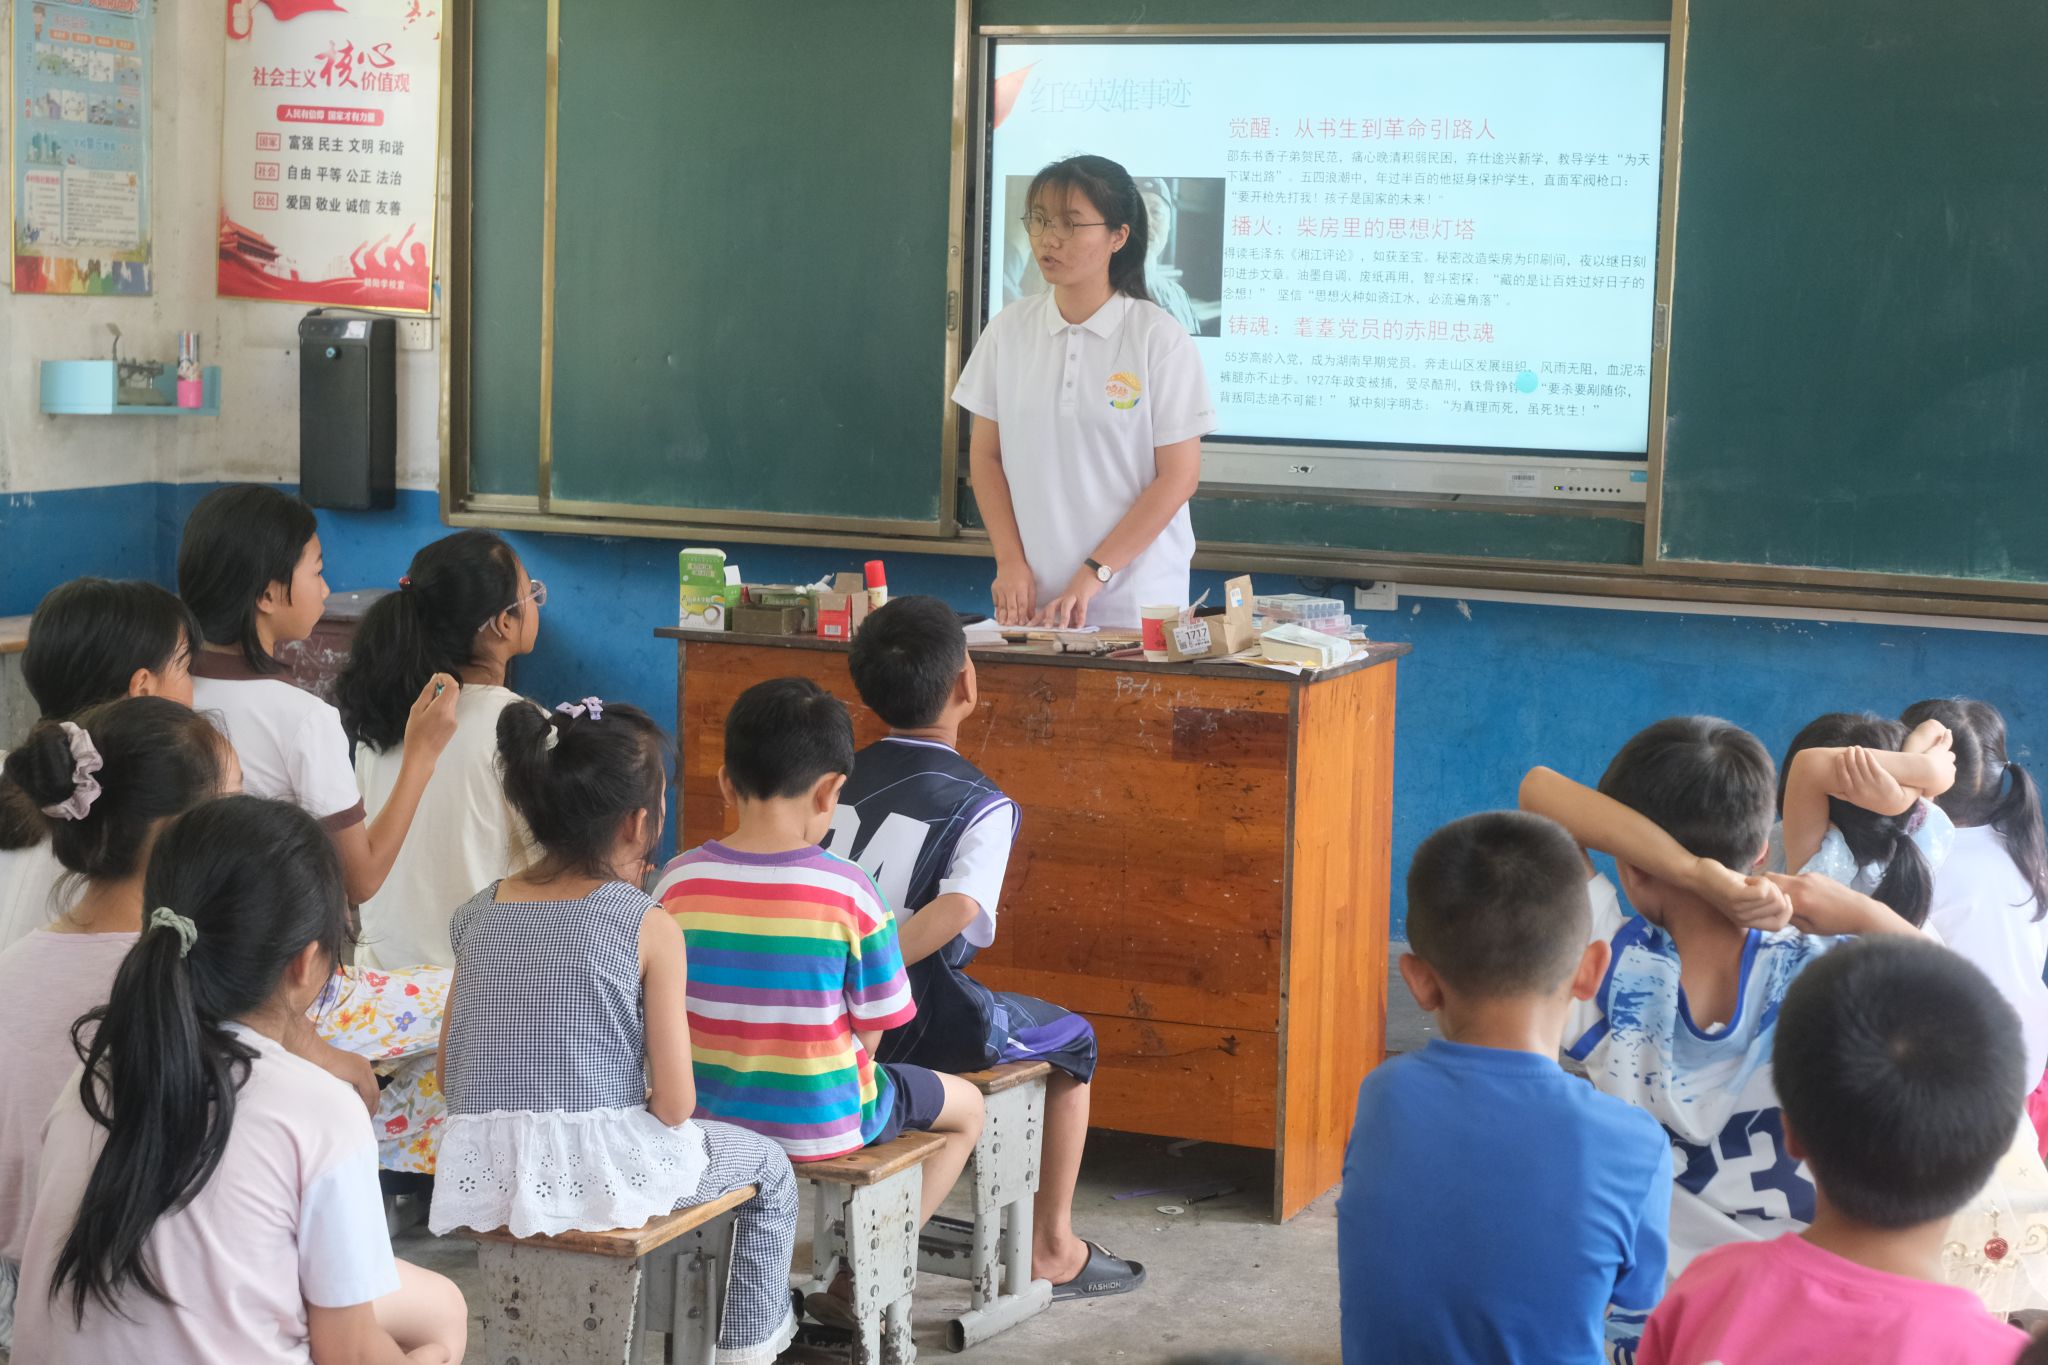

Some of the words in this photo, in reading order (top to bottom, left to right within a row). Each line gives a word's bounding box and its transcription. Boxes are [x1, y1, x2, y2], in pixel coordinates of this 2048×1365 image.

[252, 39, 410, 93] 社会主义核心价值观
[1030, 77, 1192, 113] 红色英雄事迹
[1229, 117, 1495, 140] 觉醒：从书生到革命引路人
[258, 136, 277, 148] 国家
[288, 135, 314, 152] 富强
[318, 137, 344, 153] 民主
[348, 138, 374, 154] 文明
[378, 140, 404, 156] 和谐
[258, 166, 277, 178] 社会
[287, 165, 312, 180] 自由
[316, 167, 342, 183] 平等
[346, 168, 372, 184] 公正
[376, 170, 402, 186] 法治
[256, 196, 276, 208] 公民
[286, 194, 311, 210] 爱国
[315, 196, 341, 213] 敬业
[345, 198, 371, 215] 诚信
[375, 199, 401, 216] 友善
[1231, 215, 1476, 240] 播火：柴房里的思想灯塔
[1228, 314, 1494, 343] 铸魂：耄耋党员的赤胆忠魂
[1220, 371, 1631, 398] 裤腿亦不止步。1927年政变被捕，受尽酷刑，铁骨铮铮“要杀要剐随你，
[1088, 1281, 1121, 1292] FASHION
